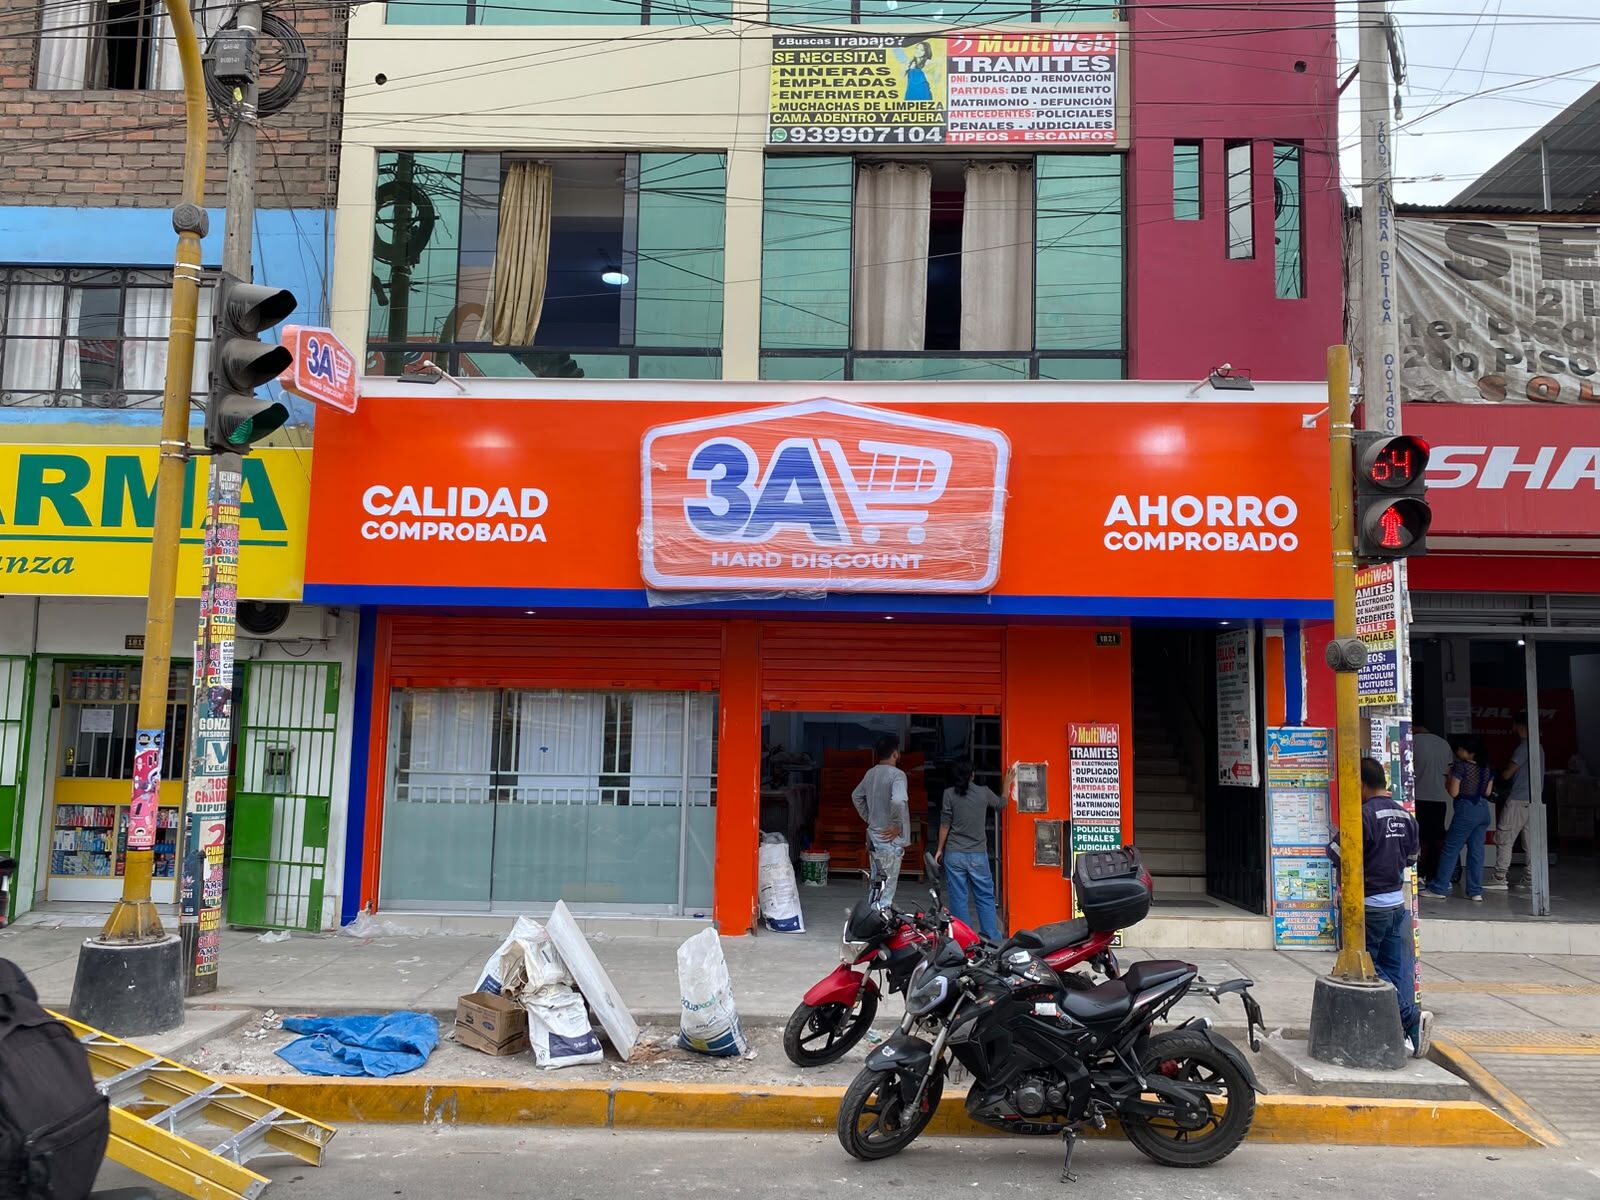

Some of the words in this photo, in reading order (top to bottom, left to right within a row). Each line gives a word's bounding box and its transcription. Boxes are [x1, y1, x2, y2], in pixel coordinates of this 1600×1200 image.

[778, 37, 831, 46] ¿Buscas
[834, 36, 905, 48] Trabajo?
[977, 34, 1112, 53] MultiWeb
[774, 52, 795, 64] SE
[799, 51, 884, 64] NECESITA:
[952, 56, 1111, 72] TRAMITES
[779, 65, 891, 77] NIÑERAS
[779, 78, 897, 88] EMPLEADAS
[950, 75, 968, 83] DNI:
[970, 75, 1032, 83] DUPLICADO
[779, 90, 899, 100] ENFERMERAS
[1031, 86, 1111, 94] NACIMIENTO
[779, 102, 860, 111] MUCHACHAS
[864, 102, 881, 111] DE
[885, 102, 944, 111] LIMPIEZA
[950, 99, 1029, 107] MATRIMONIO
[772, 113, 811, 123] CAMA
[814, 113, 877, 123] ADENTRO
[880, 113, 888, 122] Y
[891, 112, 944, 122] AFUERA
[950, 109, 1034, 118] ANTECEDENTES:
[1036, 110, 1113, 118] POLICIALES
[950, 122, 1014, 130] PENALES
[1027, 121, 1113, 130] JUDICIALES
[789, 127, 942, 143] 939907104
[949, 132, 1009, 141] TIPEOS
[1380, 251, 1392, 323] OPTICA
[307, 337, 335, 385] 3A
[0, 454, 288, 531] RMA
[683, 437, 854, 545] 3A
[362, 485, 548, 518] CALIDAD
[1104, 495, 1298, 527] AHORRO
[361, 521, 547, 542] COMPROBADA
[1104, 531, 1298, 551] COMPROBADO
[0, 555, 75, 575] nza
[712, 551, 782, 568] HARD
[791, 552, 924, 570] DISCOUNT
[1372, 663, 1396, 672] PODER
[1078, 727, 1118, 743] MultiWeb
[1070, 747, 1118, 758] TRAMITES
[1077, 834, 1114, 842] PENALES
